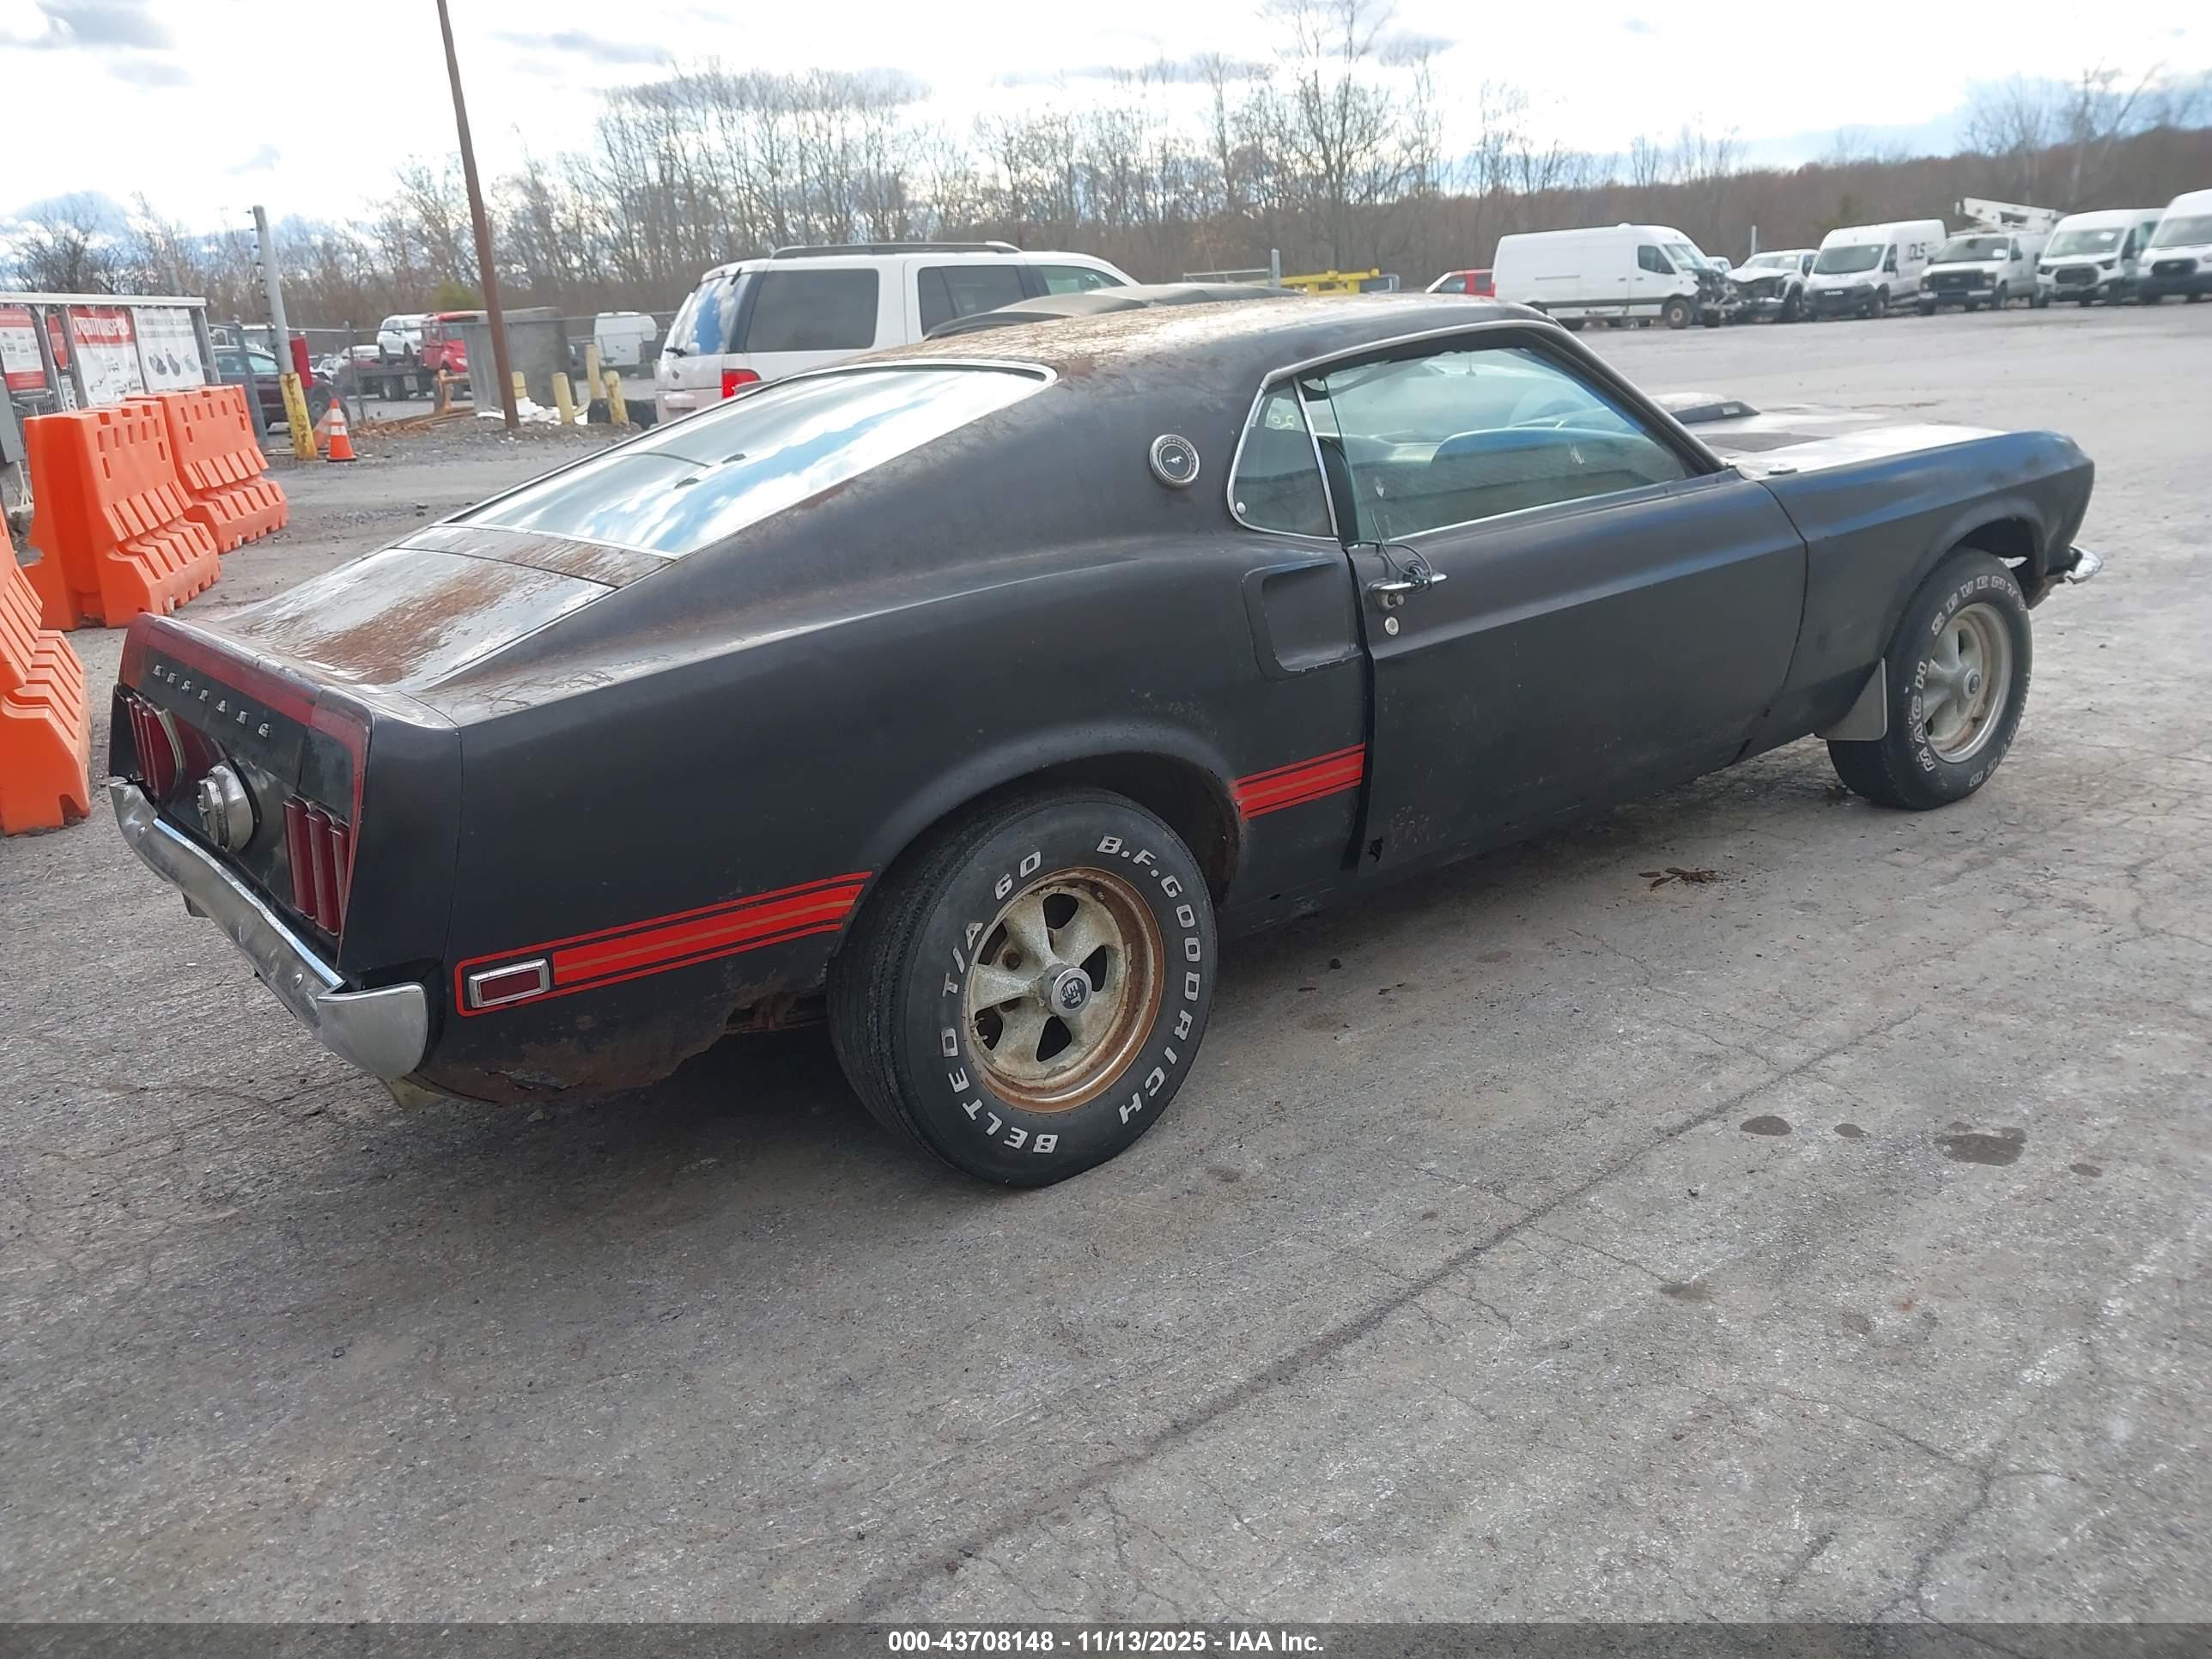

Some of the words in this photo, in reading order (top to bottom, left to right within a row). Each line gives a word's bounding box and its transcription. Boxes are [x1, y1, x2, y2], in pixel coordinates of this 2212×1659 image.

[994, 851, 1042, 900] 60
[942, 921, 983, 998] T/A
[940, 1027, 1059, 1154] BELTED
